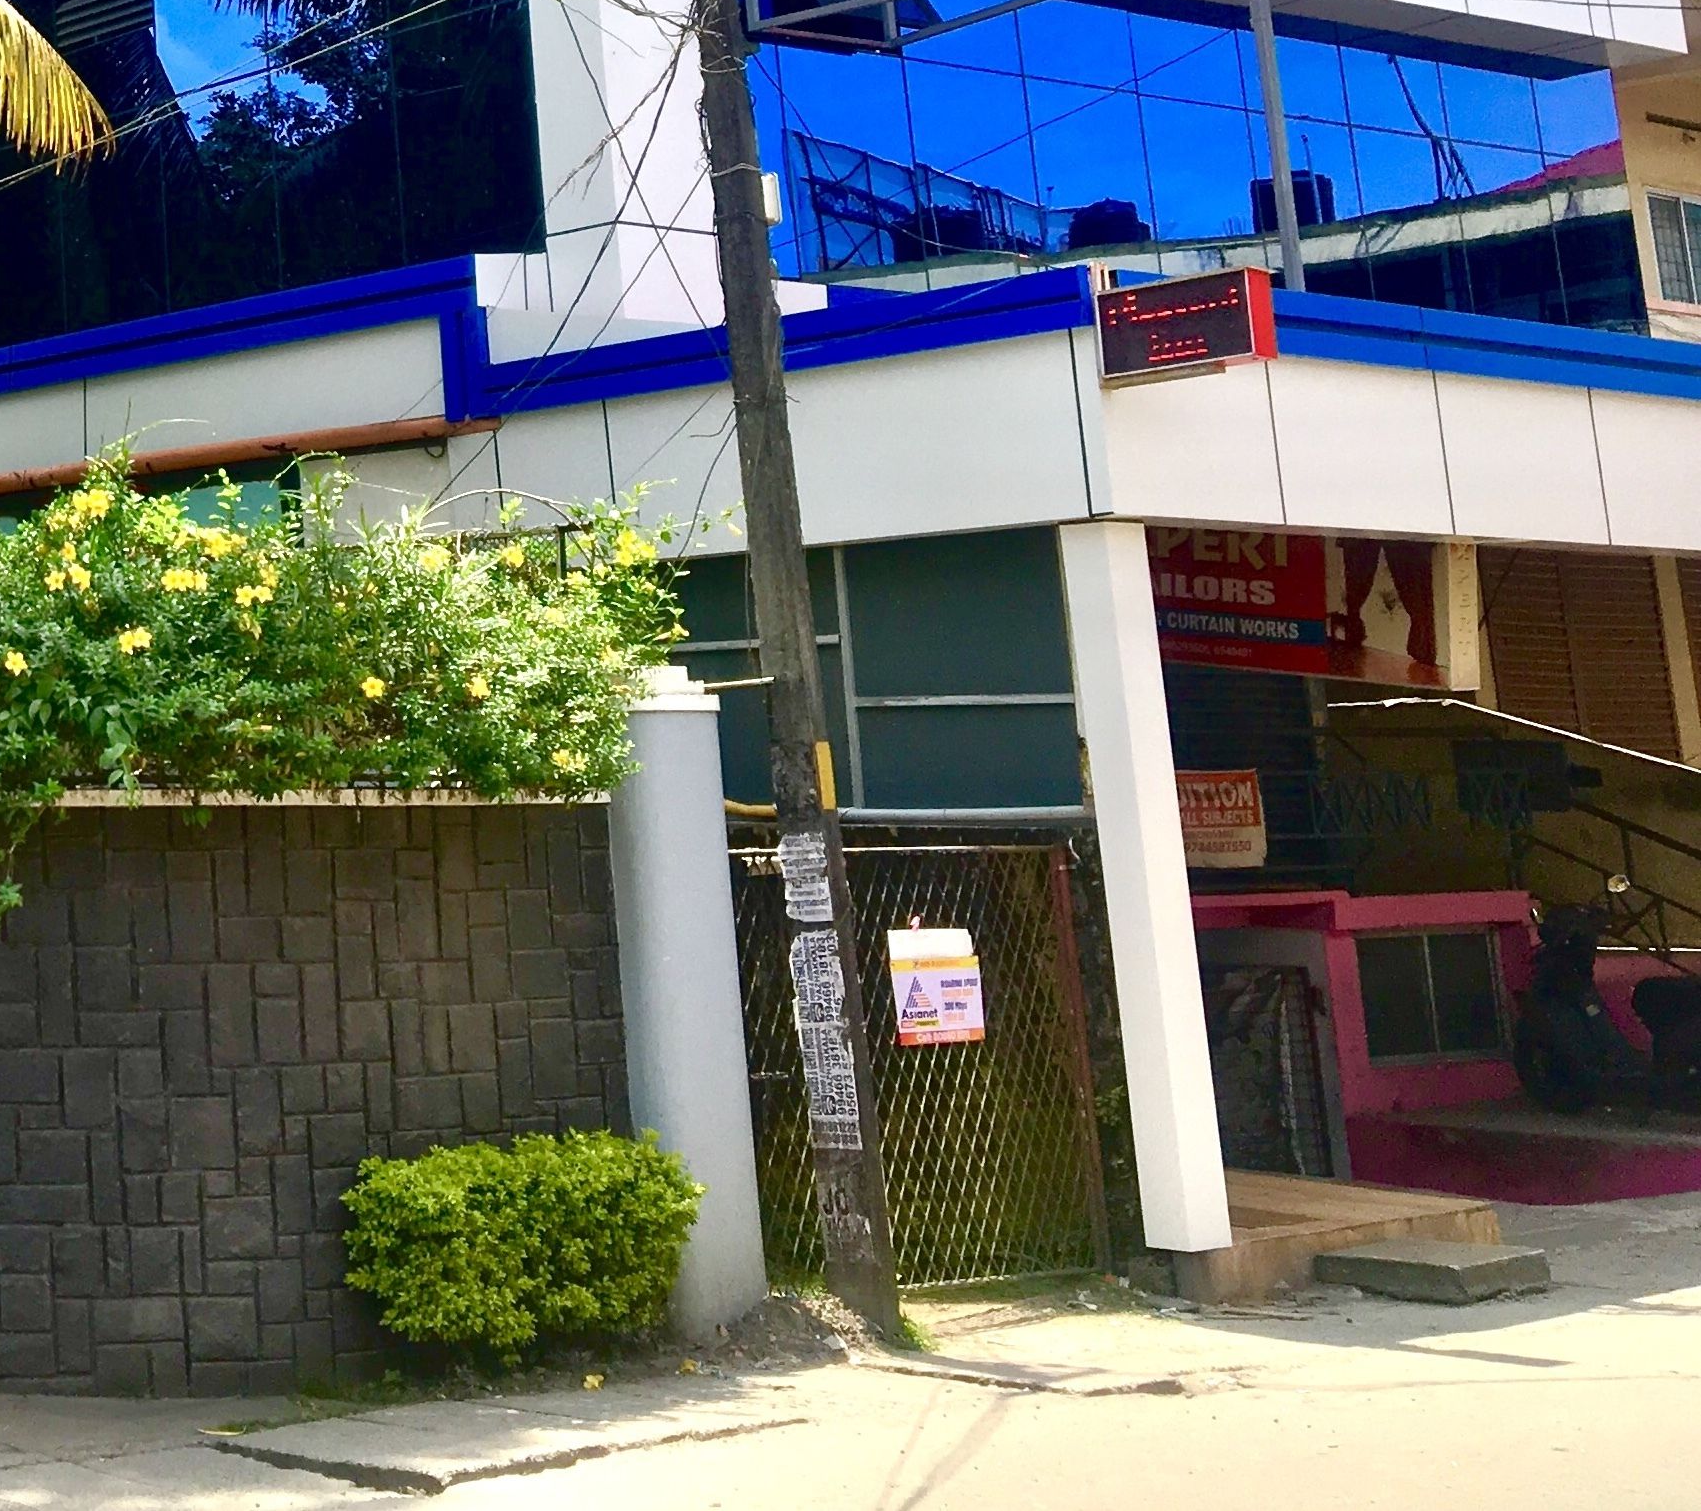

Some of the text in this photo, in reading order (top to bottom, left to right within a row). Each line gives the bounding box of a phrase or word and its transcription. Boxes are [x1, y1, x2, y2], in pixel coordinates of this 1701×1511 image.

[1149, 528, 1288, 570] PERT
[1167, 611, 1300, 640] CURTAIN WORKS
[809, 936, 822, 1001] VAZHAKKALA
[821, 982, 835, 1022] 99466
[901, 1008, 938, 1020] Asianet
[819, 1029, 834, 1094] VAZHAKKALA
[831, 1074, 847, 1116] 99466
[843, 1074, 858, 1117] 95673
